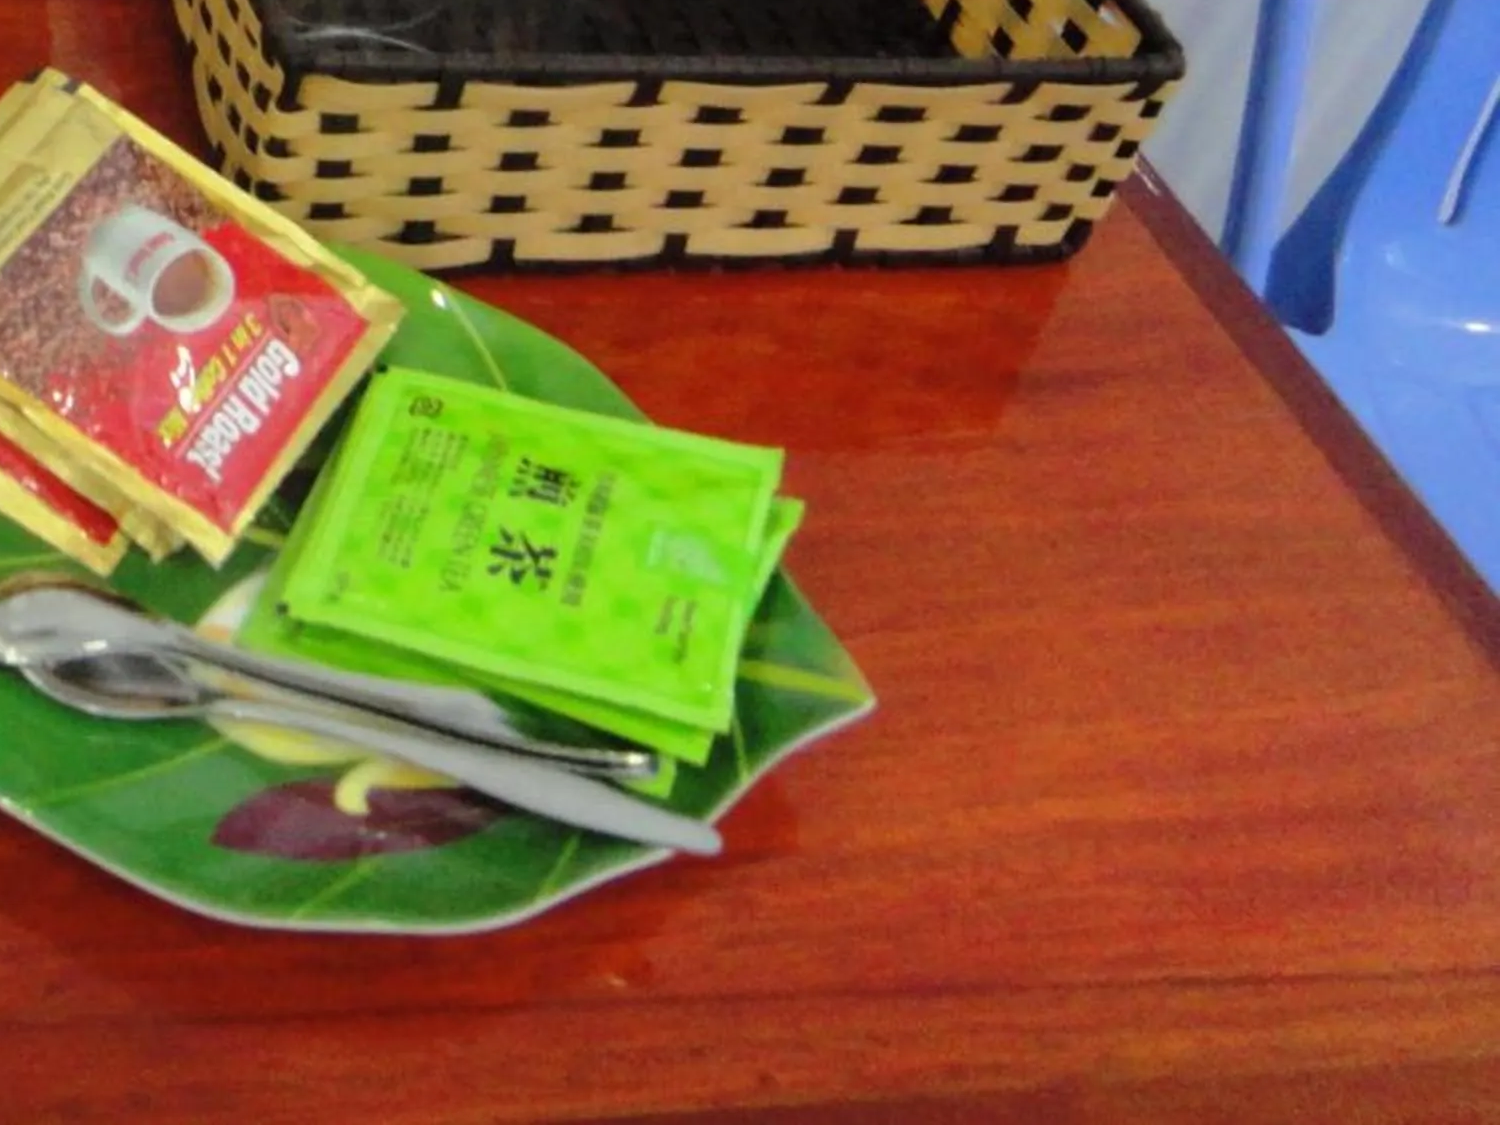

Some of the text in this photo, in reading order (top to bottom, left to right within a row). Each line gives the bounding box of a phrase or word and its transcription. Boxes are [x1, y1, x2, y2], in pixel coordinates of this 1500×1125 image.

[245, 312, 262, 338] 3
[181, 355, 227, 413] Coff
[221, 343, 237, 367] 1
[186, 338, 300, 484] Gold Roast
[486, 456, 582, 592] 煎茶
